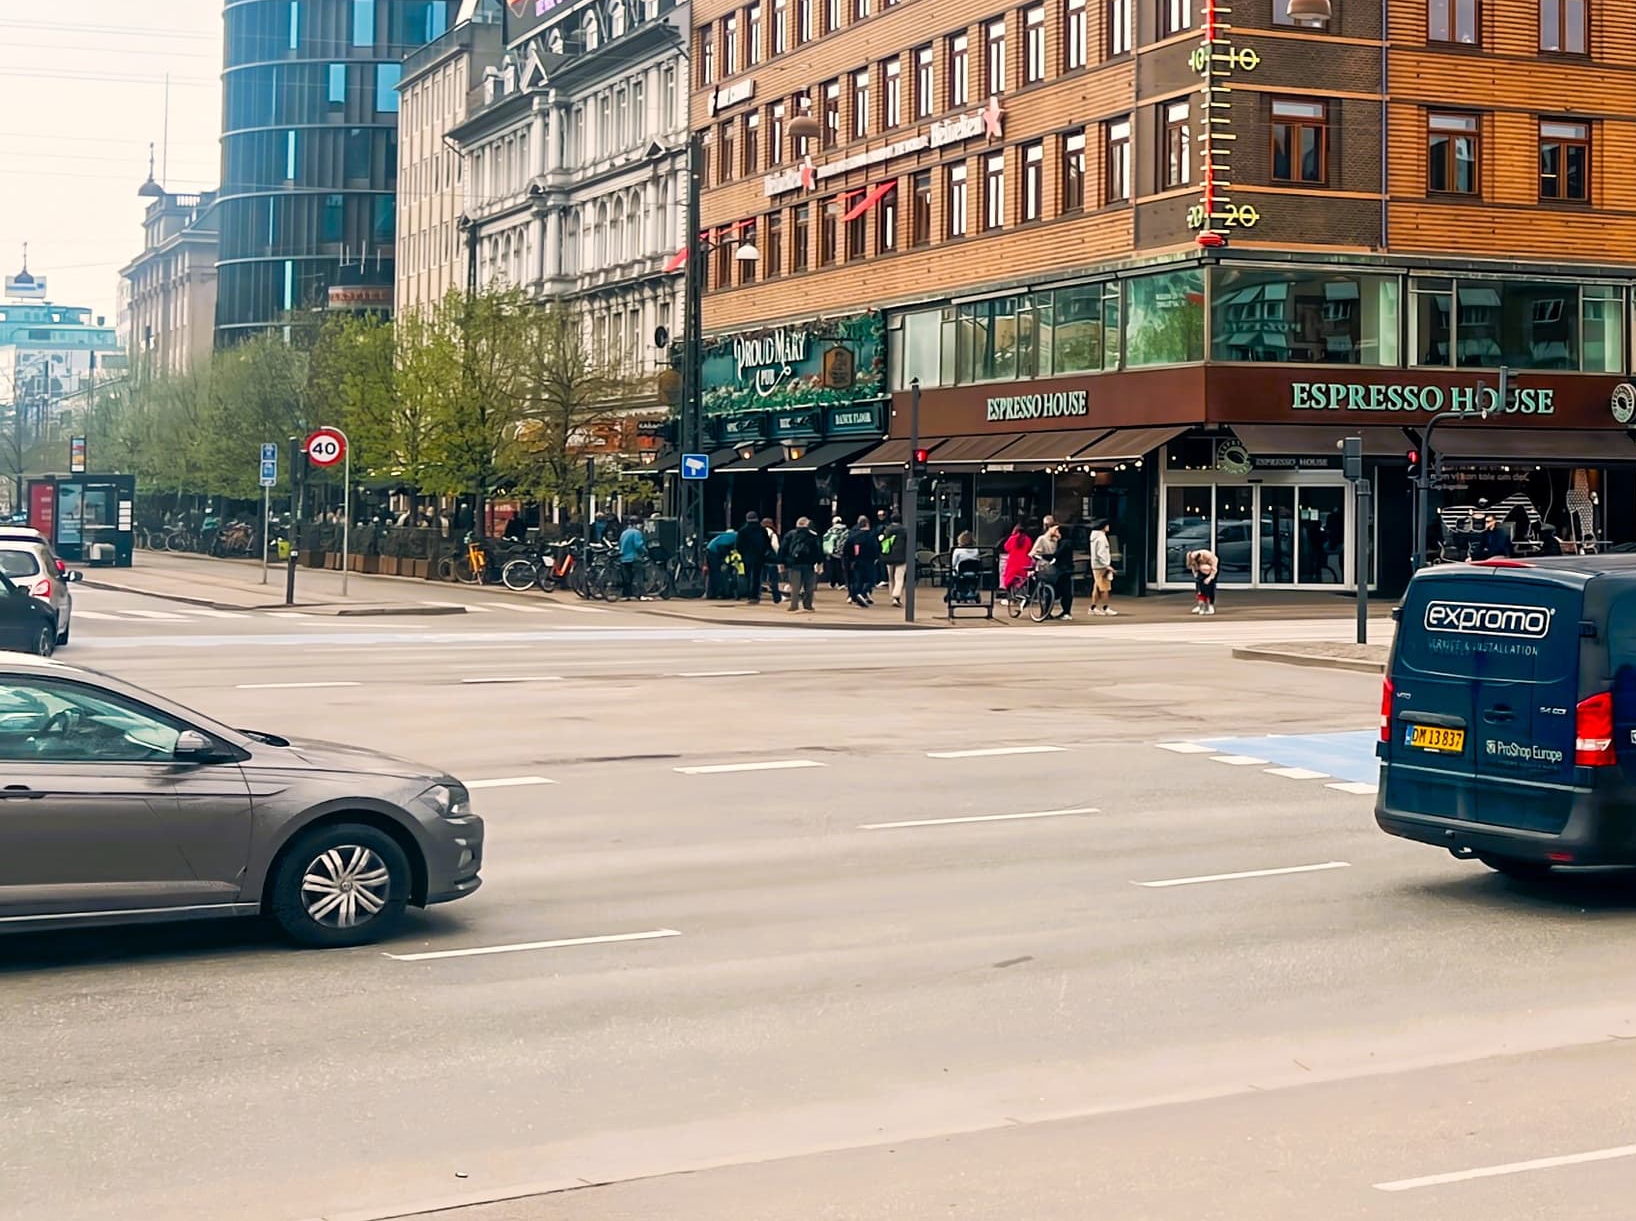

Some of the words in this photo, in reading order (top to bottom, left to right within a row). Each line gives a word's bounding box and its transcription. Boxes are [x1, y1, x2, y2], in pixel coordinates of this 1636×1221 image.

[733, 334, 774, 382] PROUD
[774, 328, 807, 364] MARY
[986, 394, 1042, 421] ESPRESSO
[1043, 390, 1087, 417] HOUSE
[1291, 382, 1445, 412] ESPRESSO
[312, 442, 336, 455] 40
[1429, 606, 1544, 632] expromo
[1411, 728, 1427, 743] DM
[1429, 730, 1441, 745] 13
[1442, 732, 1462, 747] 837
[1497, 741, 1532, 761] ProShop
[1533, 745, 1563, 764] Europe
